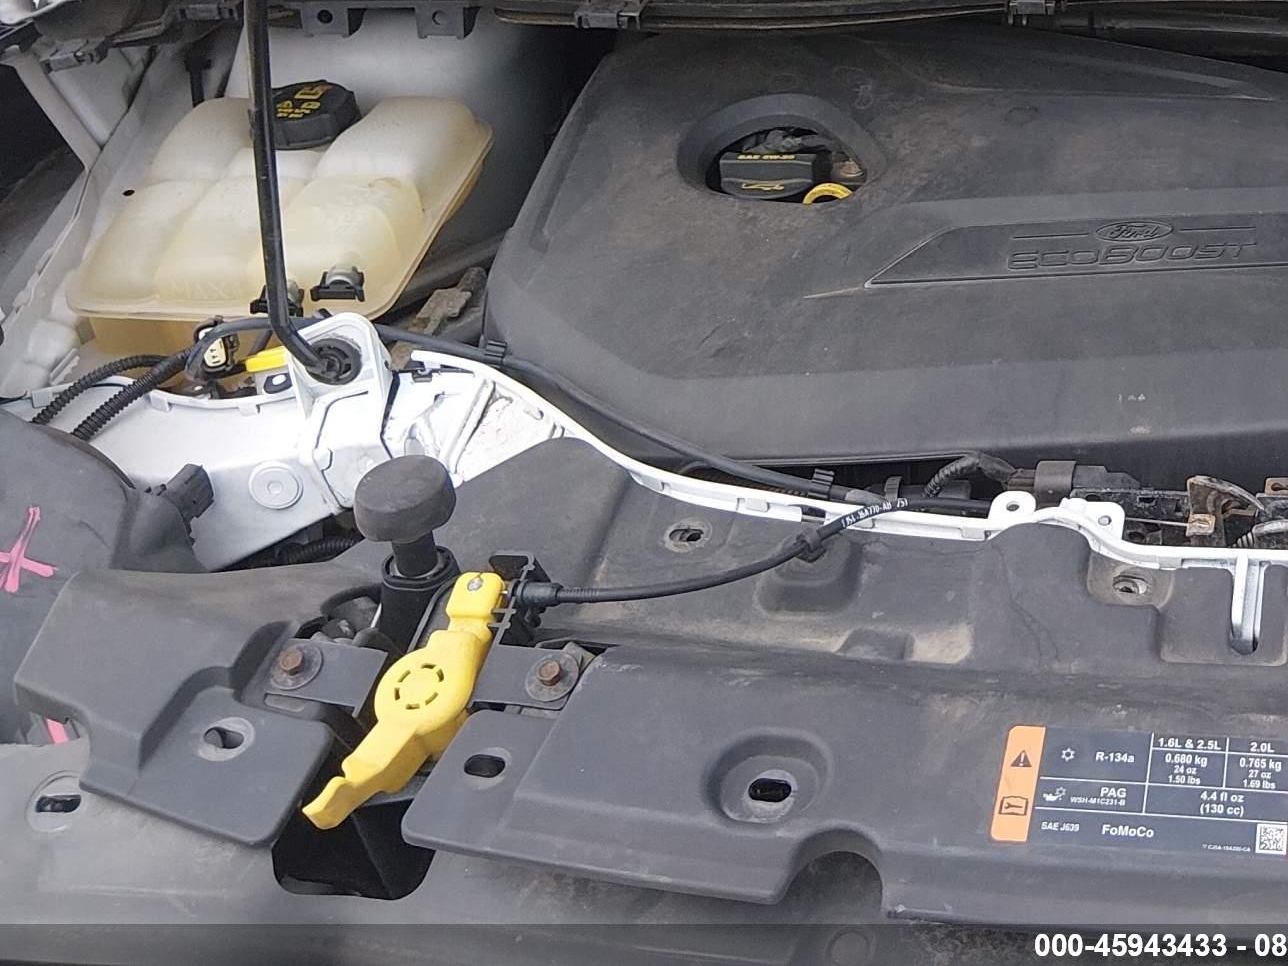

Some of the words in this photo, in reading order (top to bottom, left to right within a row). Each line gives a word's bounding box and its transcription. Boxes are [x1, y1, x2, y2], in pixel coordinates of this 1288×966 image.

[1158, 737, 1183, 748] 1.6L
[1185, 739, 1194, 748] &
[1197, 739, 1222, 750] 2.5L
[1250, 742, 1275, 753] 2.0L
[1095, 751, 1135, 763] R-134a
[1165, 753, 1192, 764] 0.680
[1194, 754, 1208, 767] kg
[1173, 765, 1185, 774] 24
[1186, 767, 1197, 775] oz
[1239, 757, 1267, 769] 0.765
[1268, 759, 1282, 772] kg
[1168, 775, 1186, 783] 1.50
[1187, 776, 1201, 784] lbs
[1248, 770, 1260, 778] 27
[1260, 771, 1272, 779] oz
[1243, 779, 1261, 788] 1.69
[1262, 780, 1276, 789] lbs
[1100, 787, 1126, 798] PAG
[1200, 791, 1218, 801] 4.4
[1219, 792, 1228, 802] fl
[1230, 794, 1244, 803] oz
[1199, 803, 1224, 815] (130
[1226, 806, 1245, 818] cc)
[1041, 822, 1060, 831] SAE
[1101, 824, 1154, 838] FoMoCo
